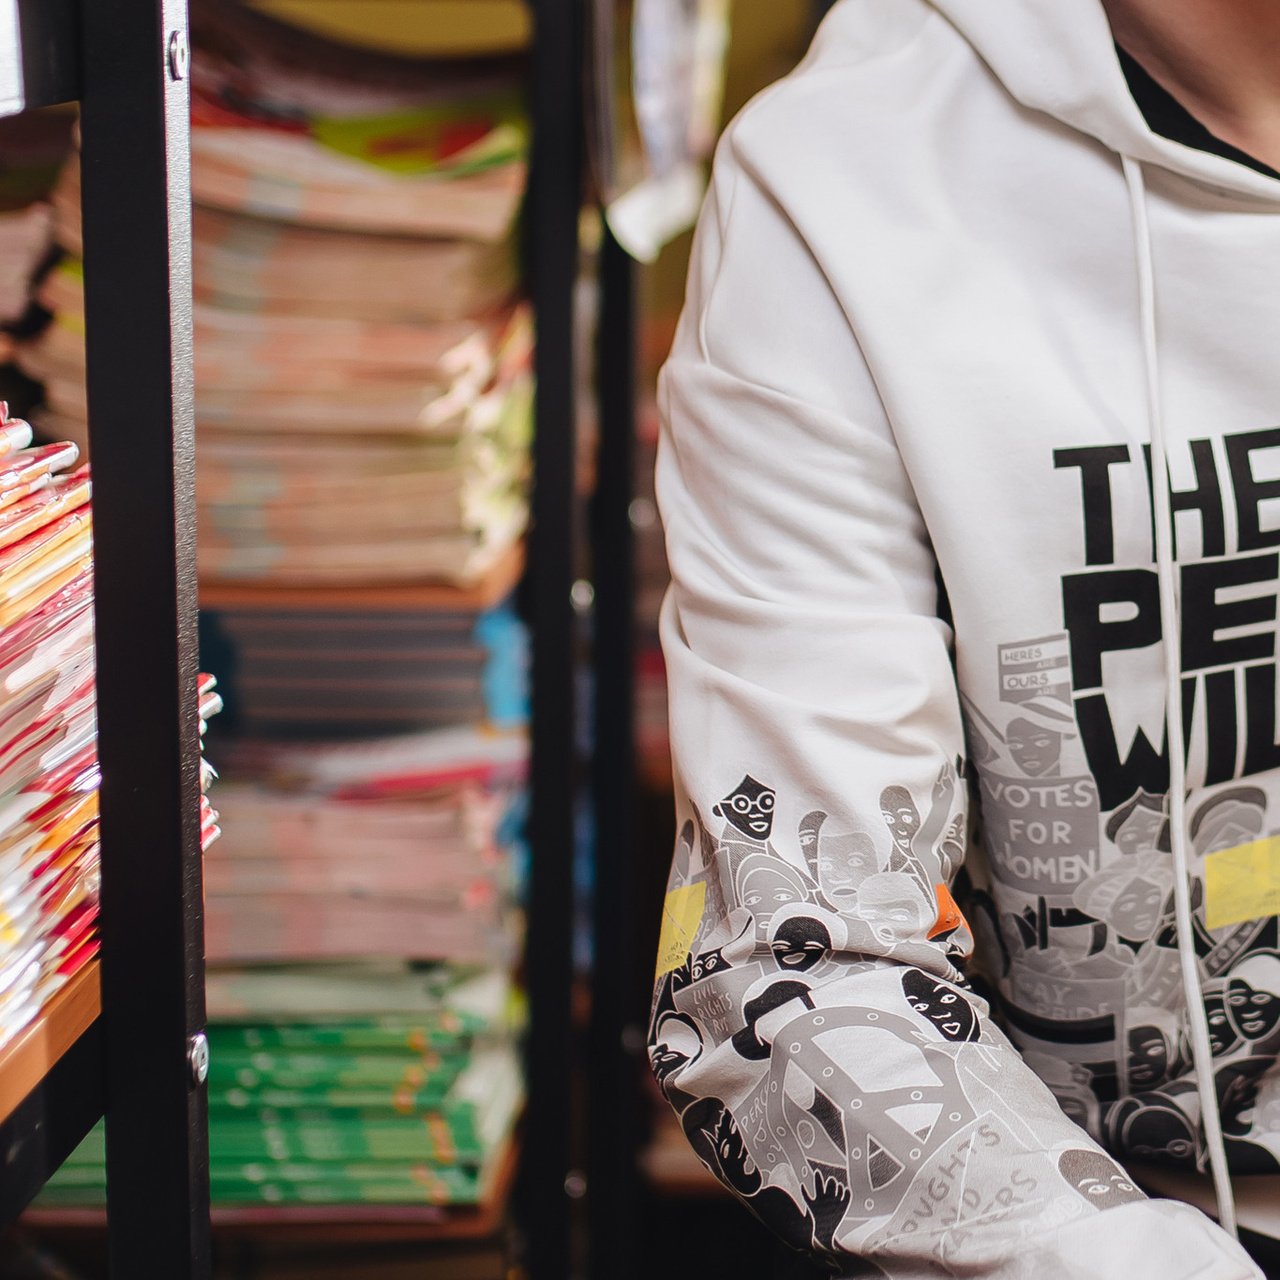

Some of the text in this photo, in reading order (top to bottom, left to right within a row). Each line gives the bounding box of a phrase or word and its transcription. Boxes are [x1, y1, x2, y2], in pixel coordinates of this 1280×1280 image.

[1007, 672, 1049, 689] OURS
[983, 778, 1096, 808] VOTES
[1008, 819, 1072, 845] FOR
